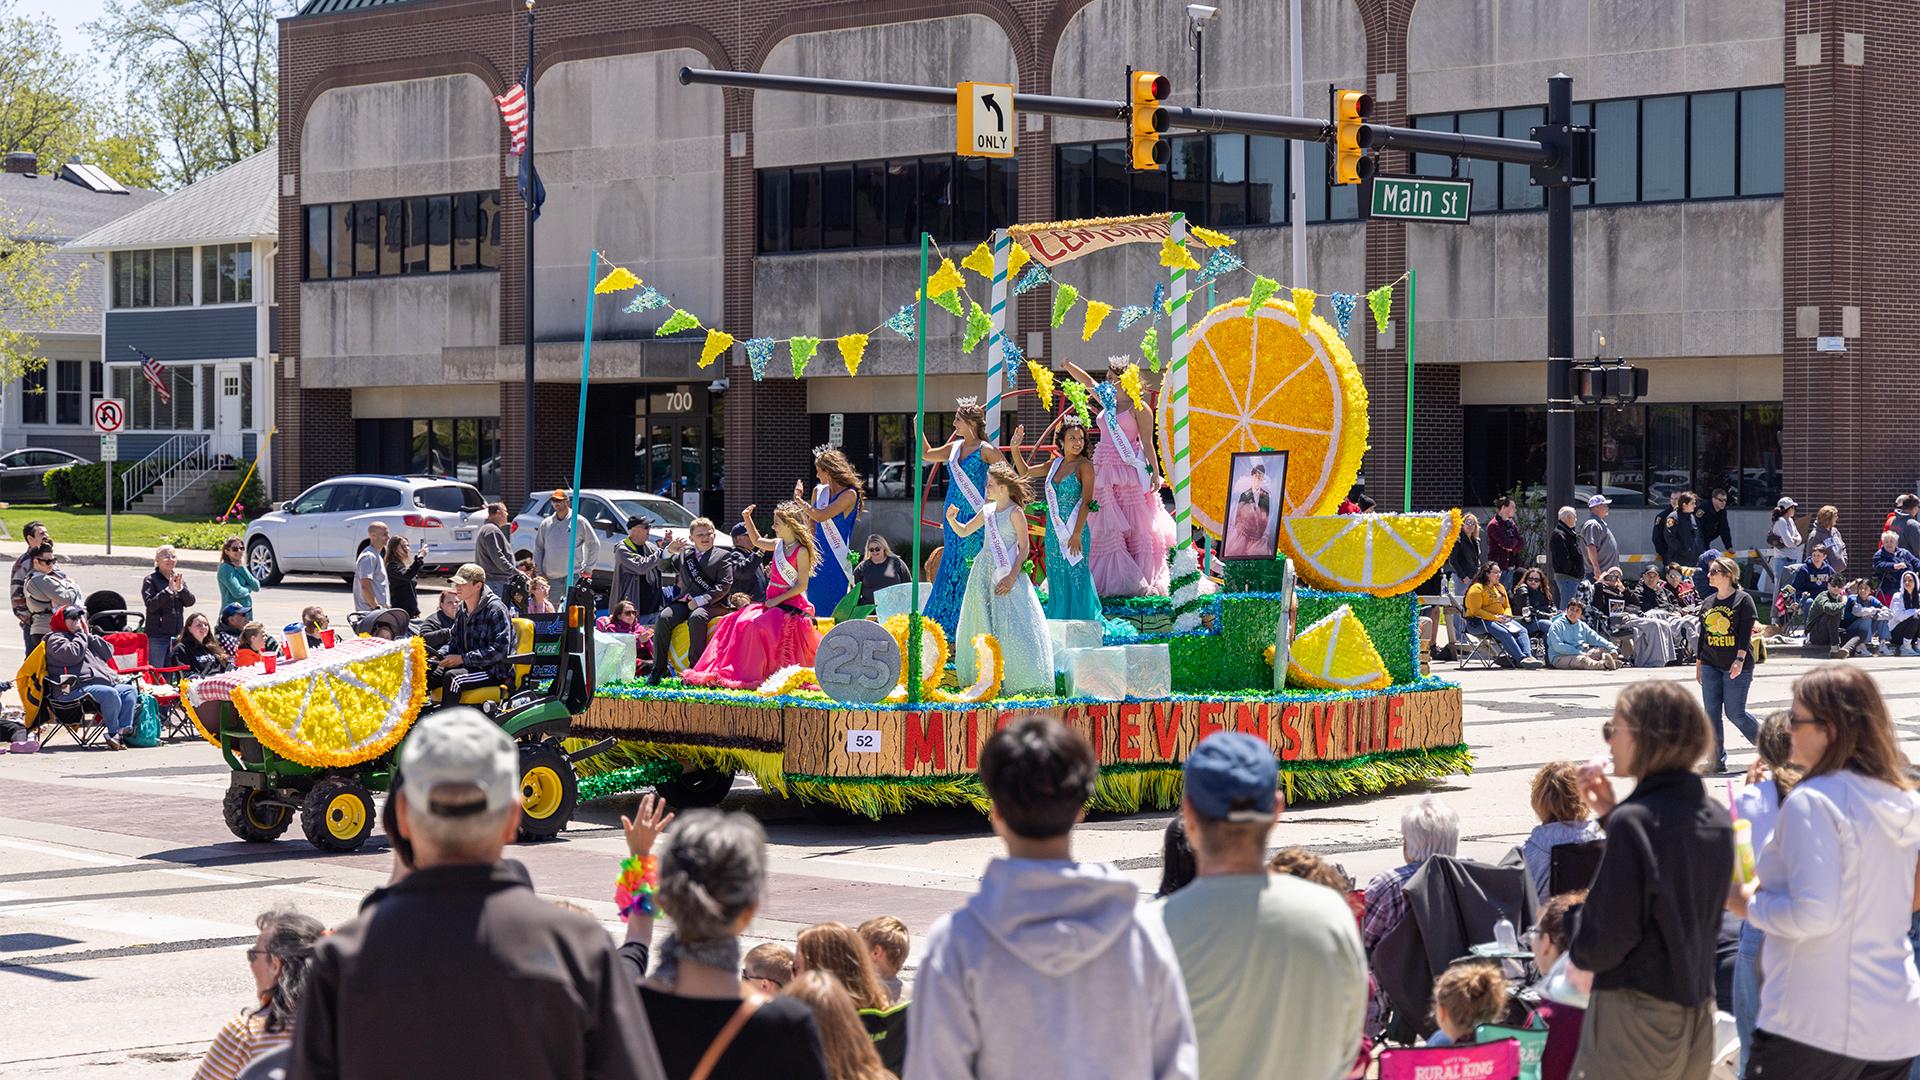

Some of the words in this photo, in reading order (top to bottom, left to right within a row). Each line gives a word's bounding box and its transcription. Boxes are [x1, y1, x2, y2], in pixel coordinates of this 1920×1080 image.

[977, 134, 1008, 149] ONLY
[1383, 183, 1432, 213] Main
[1030, 221, 1171, 261] LEMONAD
[666, 392, 692, 410] 700
[1111, 429, 1131, 458] tevensville
[537, 645, 557, 653] CARE
[1708, 635, 1735, 646] CREW
[822, 634, 891, 690] 25
[856, 736, 873, 747] 52
[905, 711, 1016, 771] MI
[1414, 1065, 1462, 1080] RURAL
[1463, 1061, 1494, 1076] KING
